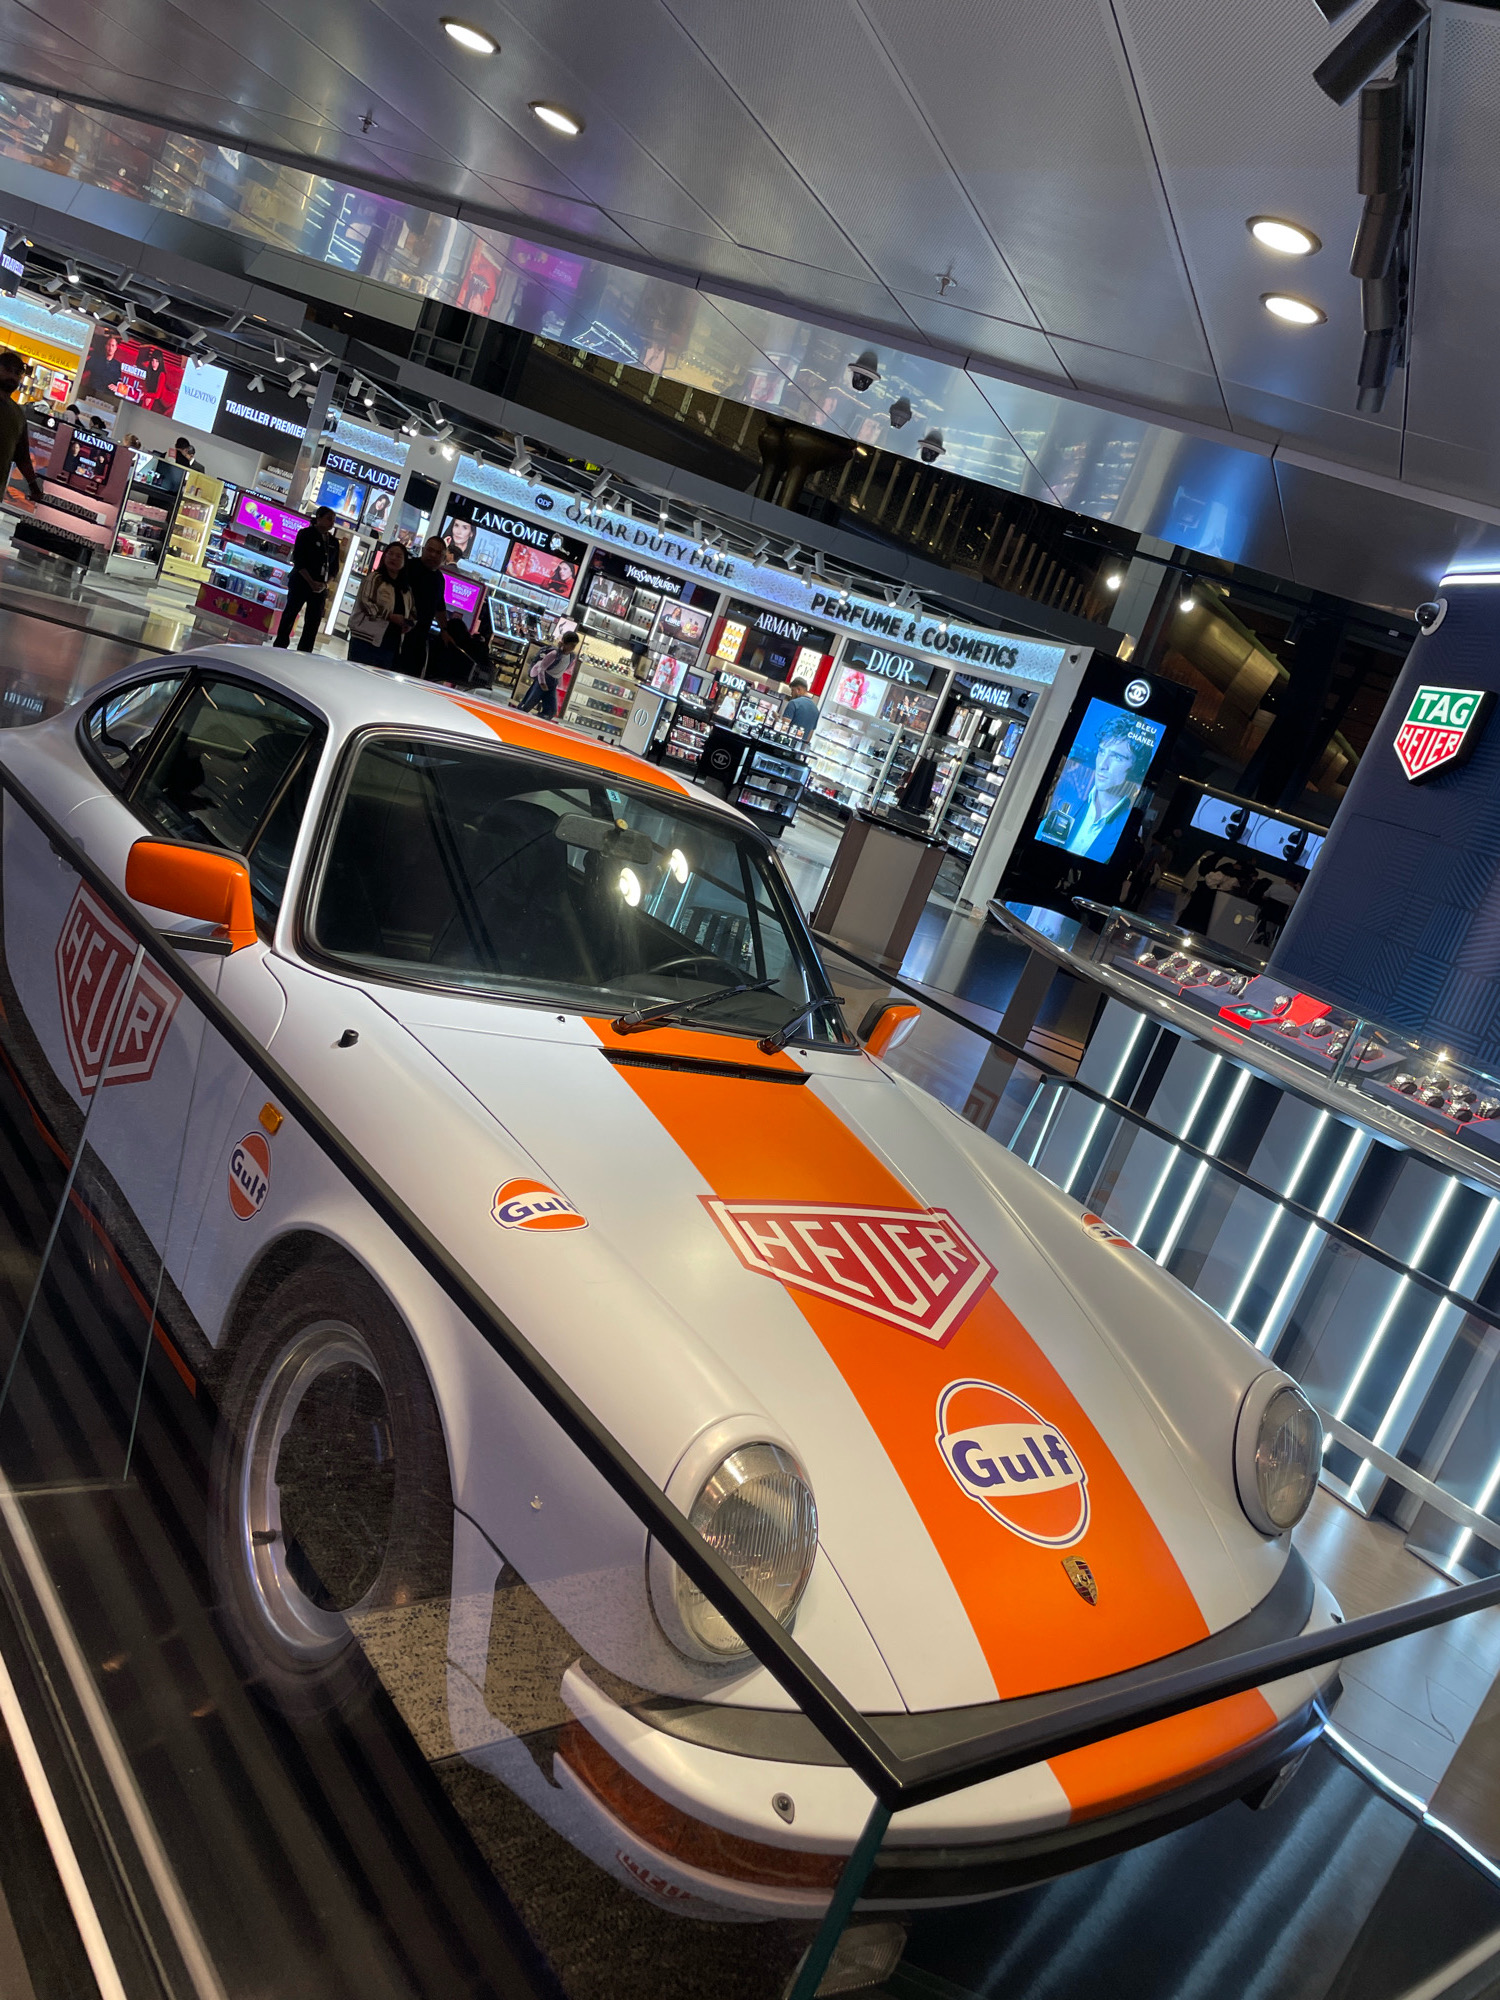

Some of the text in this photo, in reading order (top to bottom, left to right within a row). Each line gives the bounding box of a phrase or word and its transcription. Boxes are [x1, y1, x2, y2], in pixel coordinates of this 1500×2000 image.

[19, 344, 40, 357] ACQUA
[48, 356, 70, 368] PARMA
[121, 362, 147, 380] VENDETTA
[183, 385, 217, 405] VALENTINO
[225, 399, 270, 426] TRAVELLER
[74, 429, 114, 452] VALENTINO
[536, 497, 552, 508] QDF
[471, 506, 548, 548] LANCÔME
[566, 505, 735, 578] QATAR DUTY FREE
[665, 615, 681, 627] LIBRE
[754, 612, 804, 641] ARMANI
[810, 592, 1019, 669] PERFUME & COSMETICS
[866, 649, 914, 684] DIOR
[719, 672, 746, 691] DIOR
[970, 683, 1011, 708] CHANEL
[1417, 692, 1475, 725] TAG
[1127, 731, 1155, 748] CHANEL
[1135, 721, 1157, 735] BLEU
[1399, 726, 1461, 773] HEUER
[65, 911, 158, 1066] HEUR
[231, 1148, 267, 1205] Gulf
[738, 1220, 968, 1318] HEUER
[951, 1434, 1074, 1488] Gulf
